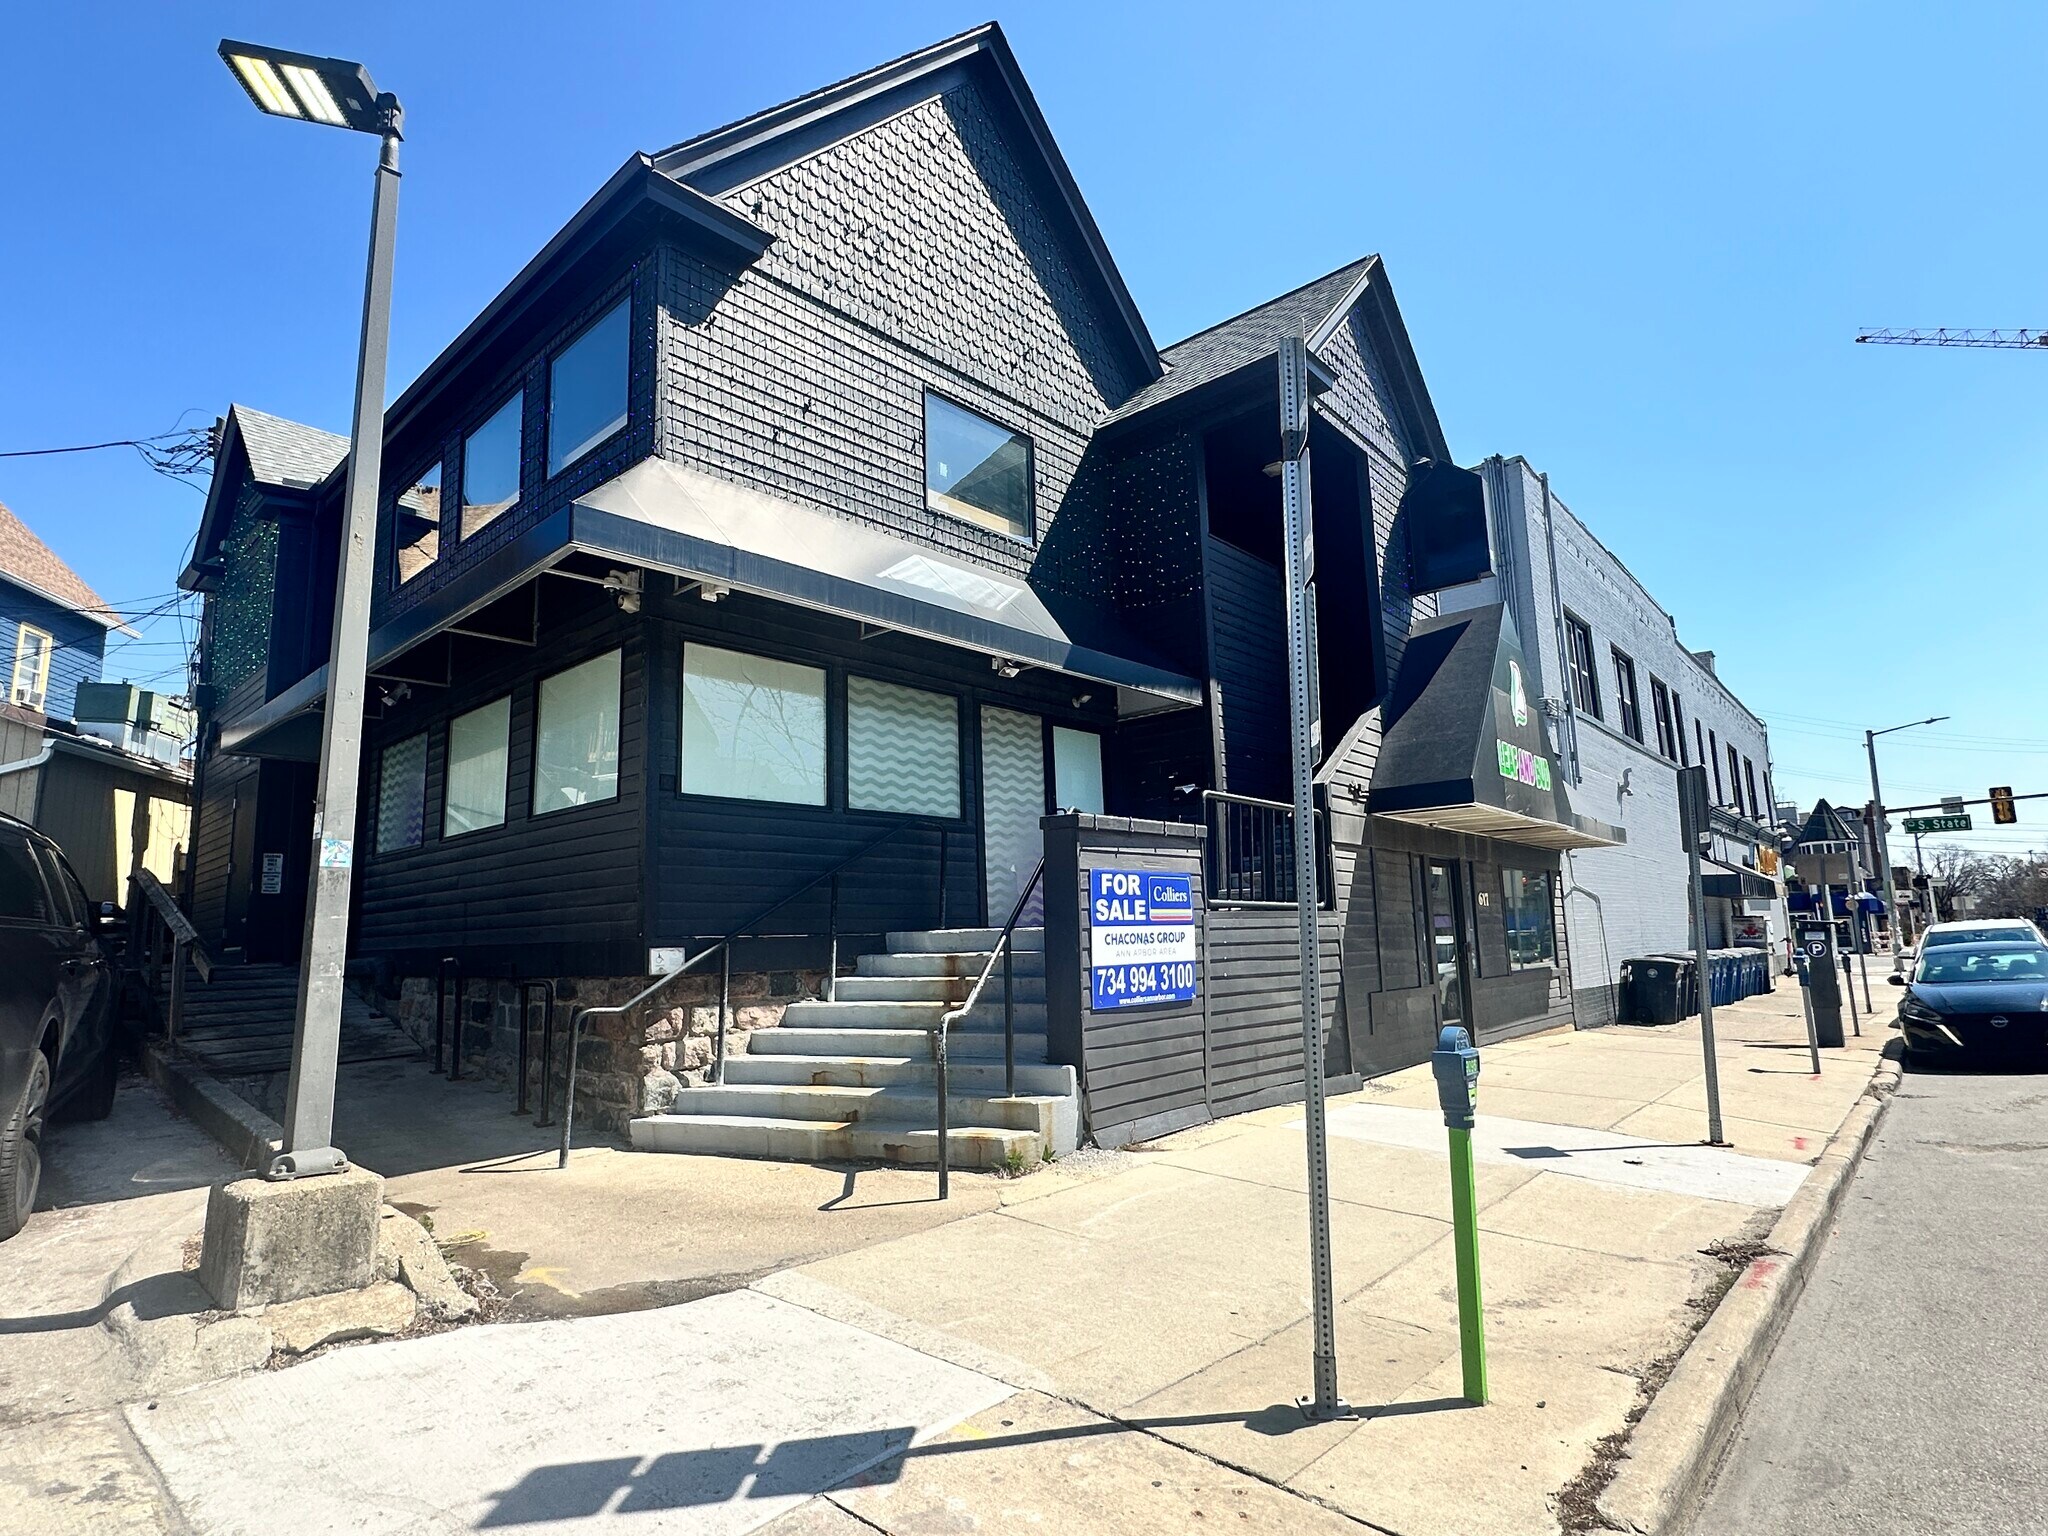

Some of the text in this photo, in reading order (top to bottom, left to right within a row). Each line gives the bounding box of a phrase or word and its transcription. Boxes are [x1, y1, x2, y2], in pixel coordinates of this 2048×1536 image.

[1918, 818, 1967, 830] S. State
[1101, 873, 1141, 896] FOR
[1153, 885, 1188, 903] Colliers
[1478, 892, 1489, 907] 617
[1096, 899, 1147, 921] SALE
[1104, 931, 1186, 946] CHACONAS GROUP
[1115, 947, 1177, 958] ANN ARBOR AREA
[1812, 943, 1822, 955] P
[1097, 963, 1193, 996] 734 994 3100
